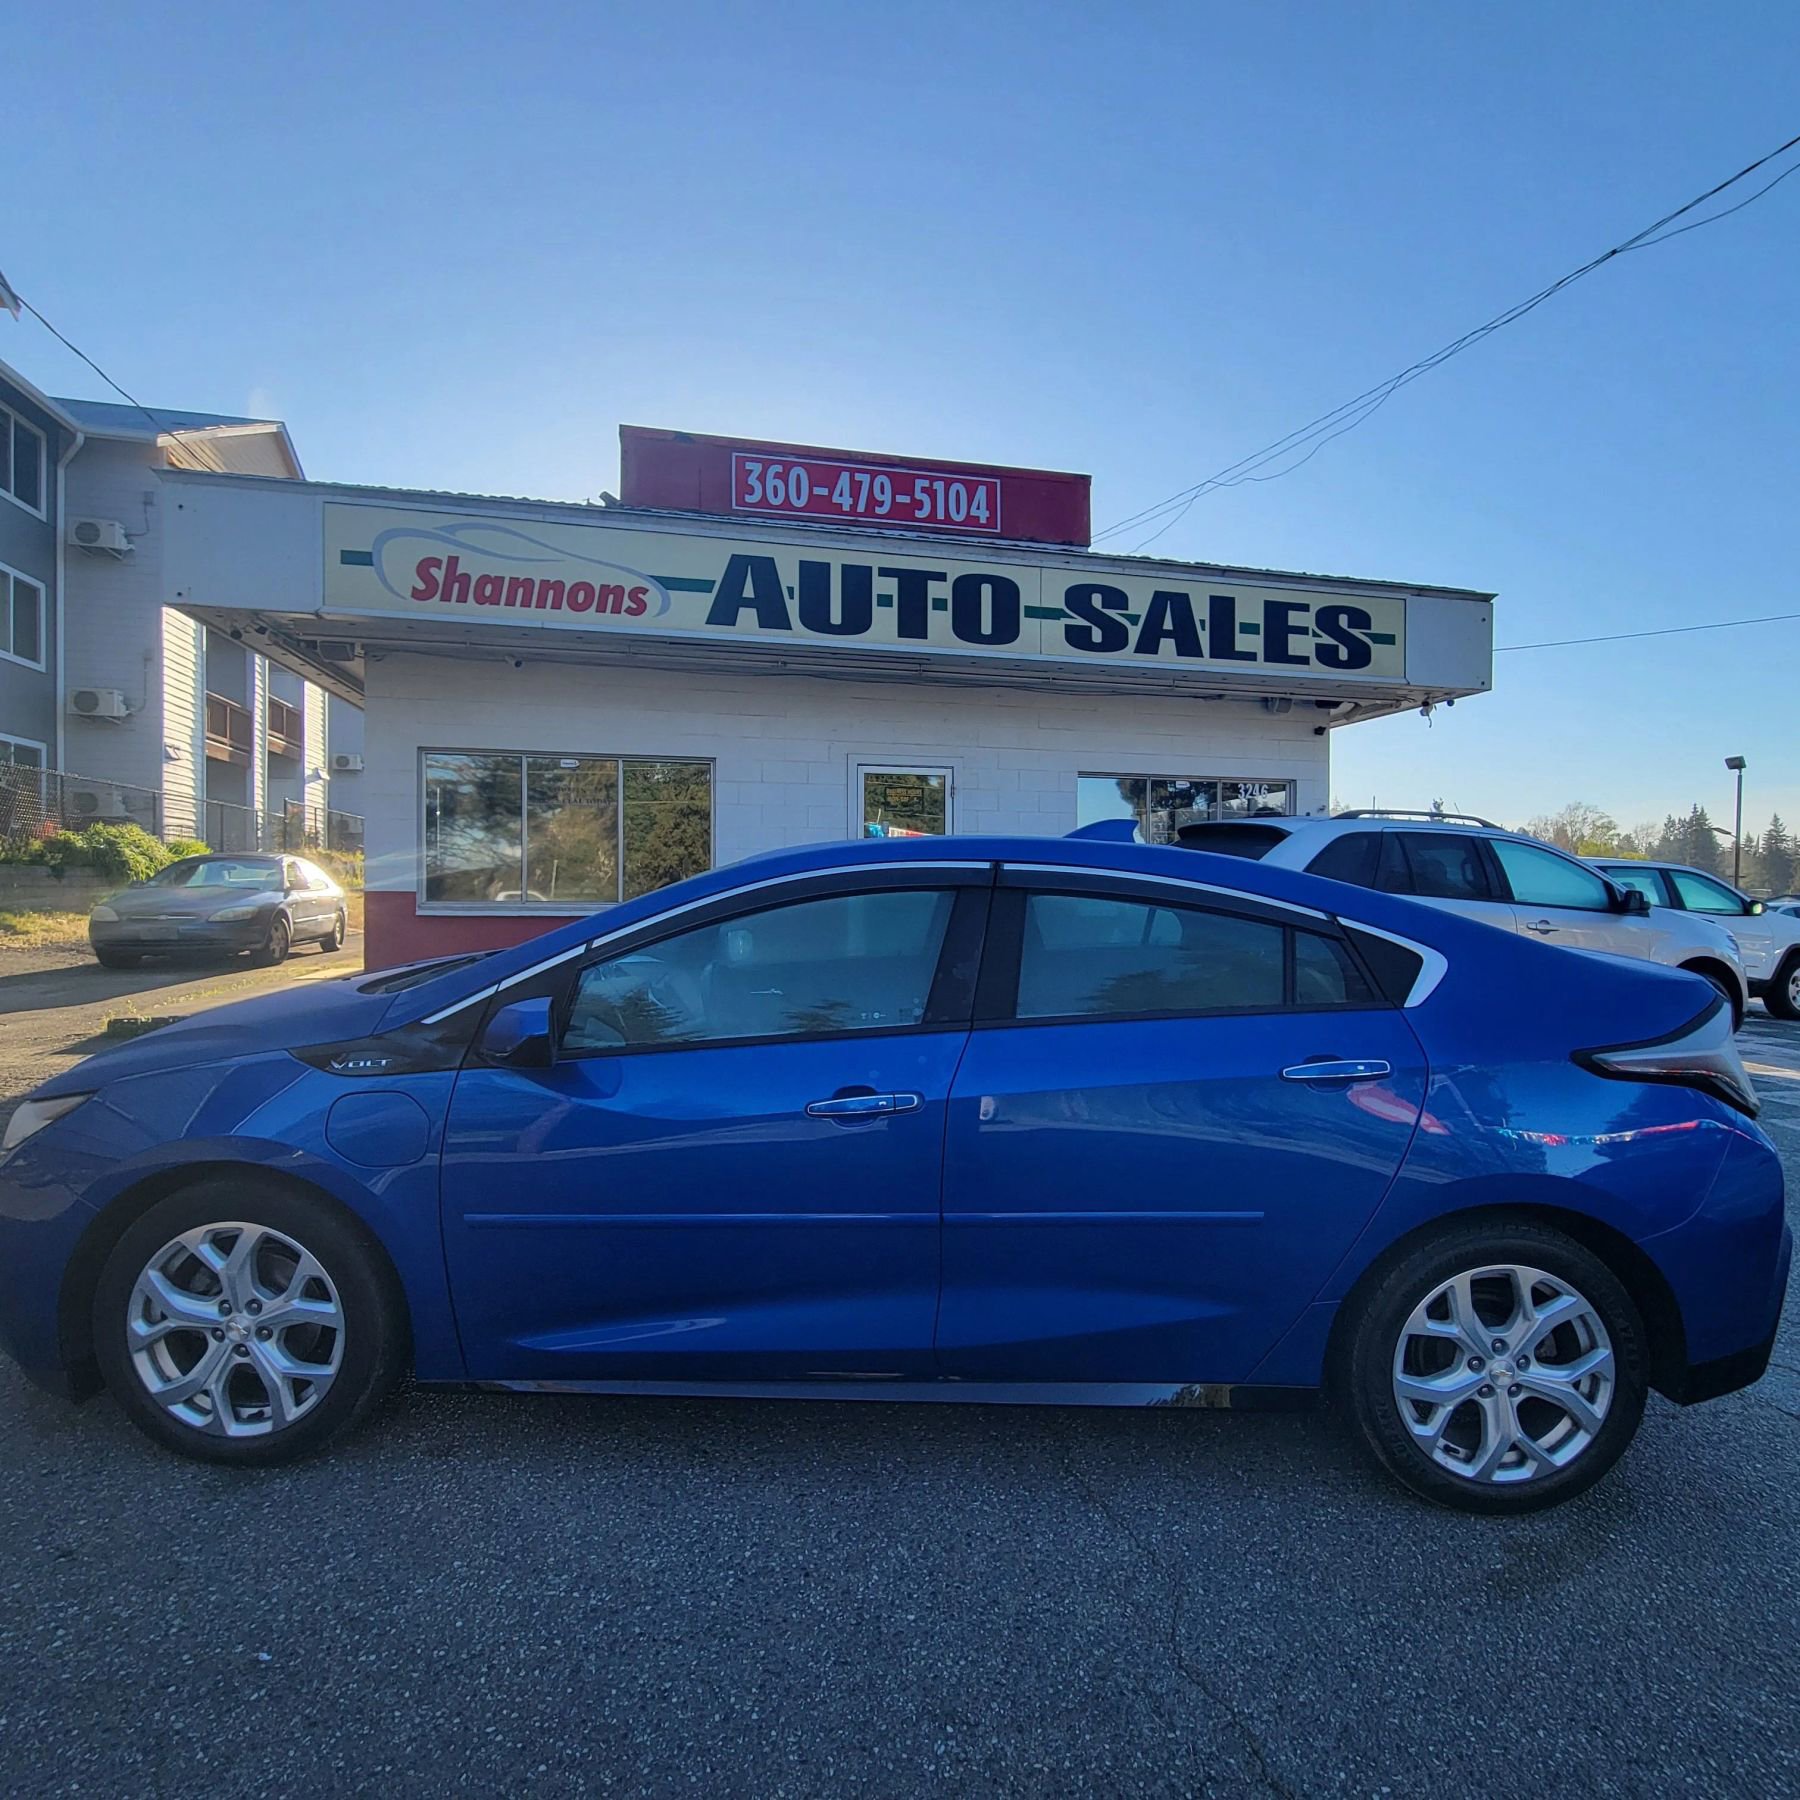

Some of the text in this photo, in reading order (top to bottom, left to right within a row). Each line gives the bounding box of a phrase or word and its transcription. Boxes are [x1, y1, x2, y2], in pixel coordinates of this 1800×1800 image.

[744, 460, 991, 525] 360-479-5104
[410, 552, 1373, 670] Shannons AUTO SALES
[1237, 783, 1269, 799] 3246
[330, 1058, 393, 1069] VOLT
